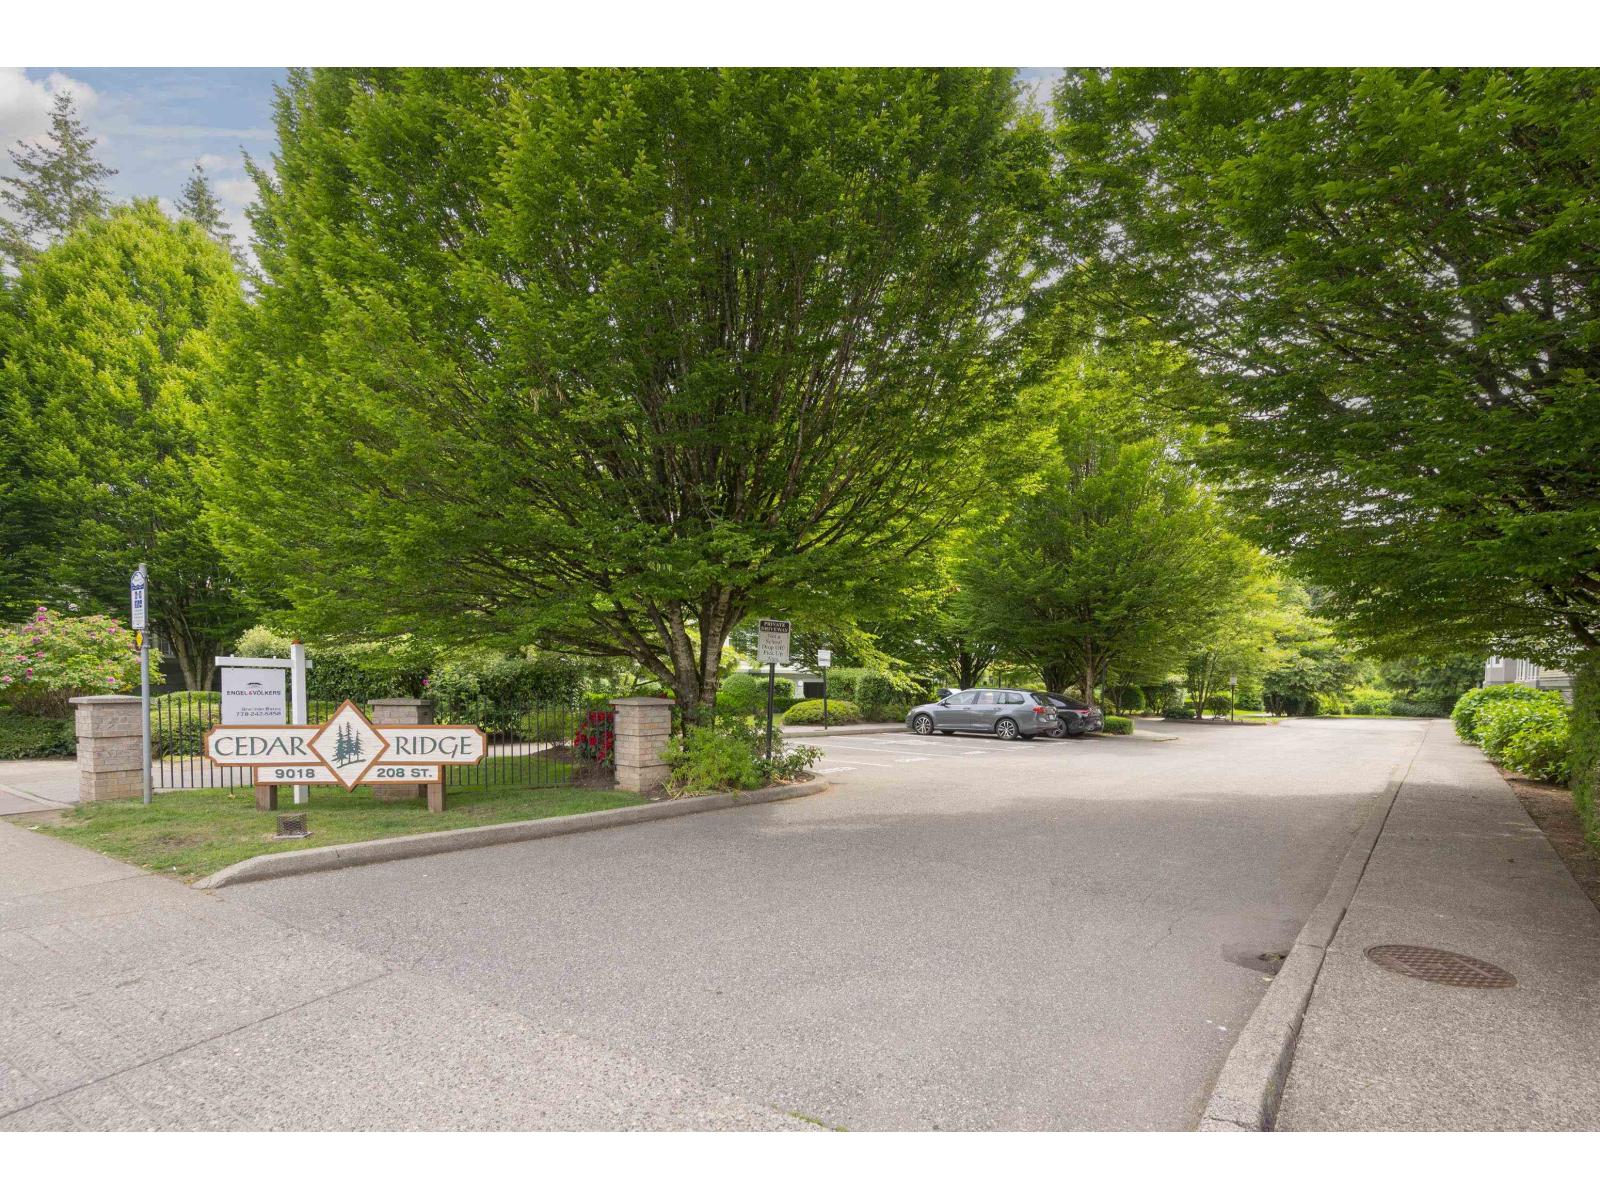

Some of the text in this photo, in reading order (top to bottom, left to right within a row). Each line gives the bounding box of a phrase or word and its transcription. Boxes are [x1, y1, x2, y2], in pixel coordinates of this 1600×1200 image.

[214, 735, 473, 759] CEDAR RIDGE
[274, 767, 433, 779] 9018 208 ST.
